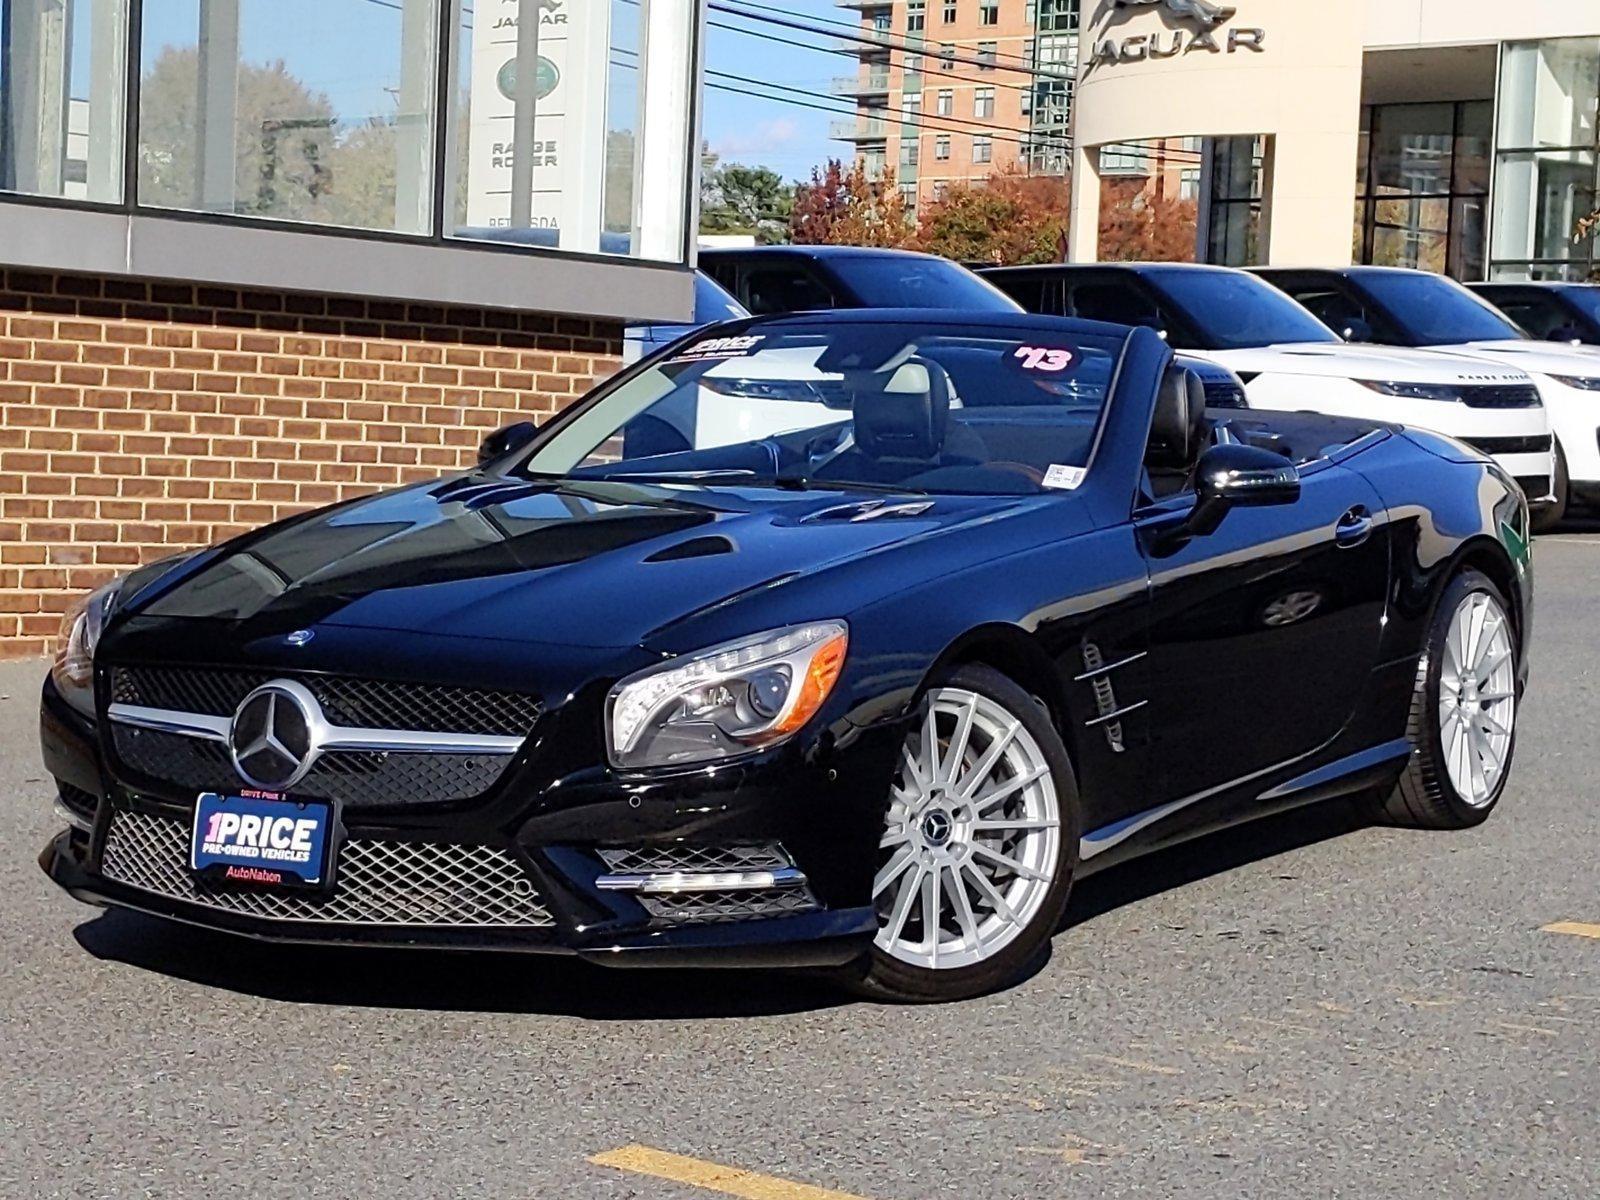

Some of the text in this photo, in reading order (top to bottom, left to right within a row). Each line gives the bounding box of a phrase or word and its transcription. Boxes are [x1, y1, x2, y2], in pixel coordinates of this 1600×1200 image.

[492, 13, 568, 29] JAAR
[1083, 28, 1266, 66] JAGUAR
[492, 141, 557, 154] RAGE
[492, 155, 558, 168] ROER
[202, 842, 310, 862] PRE-OWNED VEHICLES
[226, 865, 282, 883] AutoNation
